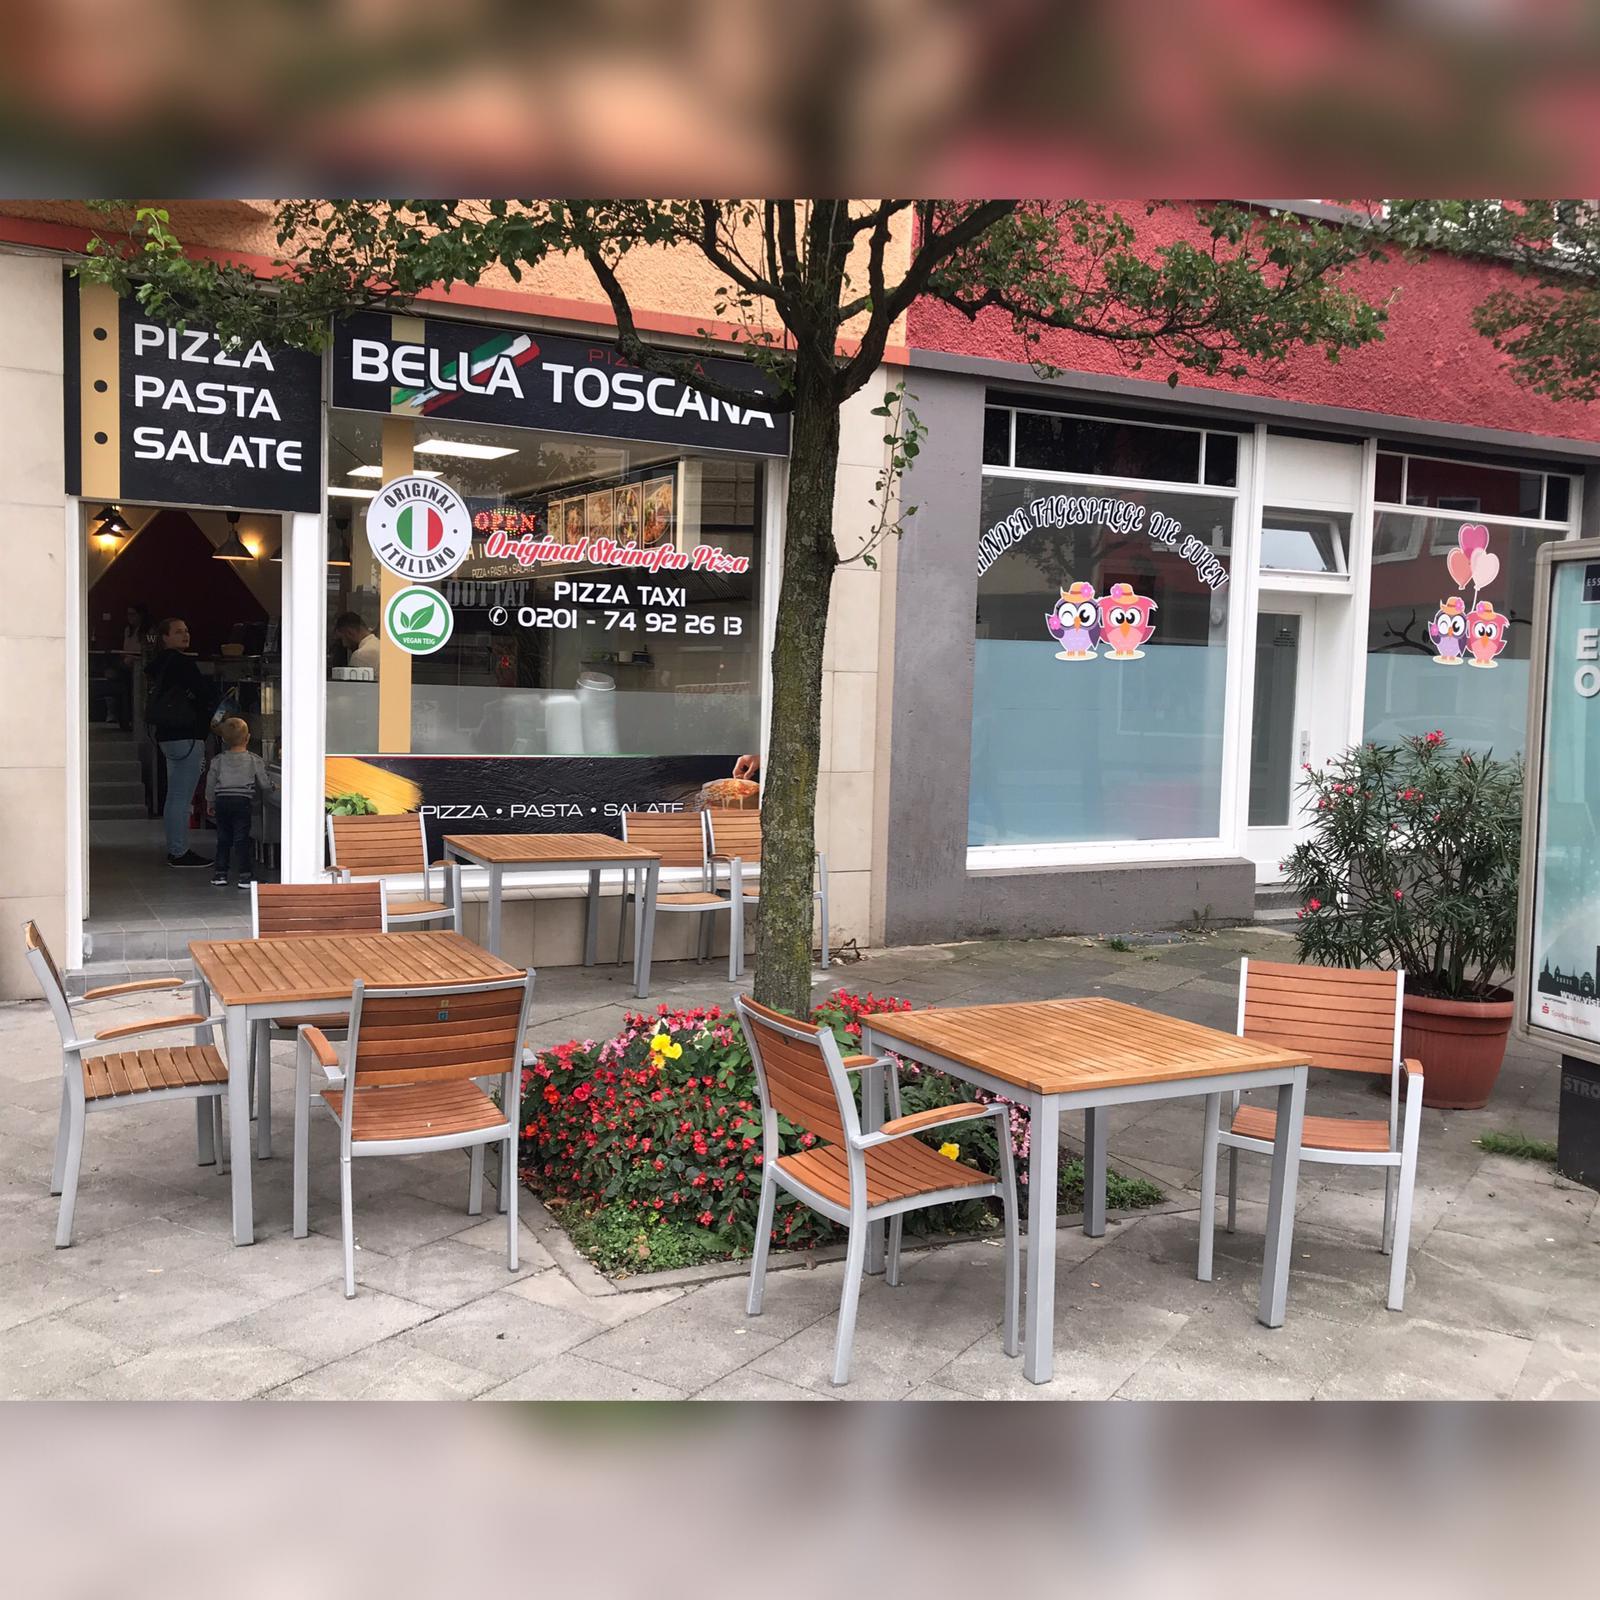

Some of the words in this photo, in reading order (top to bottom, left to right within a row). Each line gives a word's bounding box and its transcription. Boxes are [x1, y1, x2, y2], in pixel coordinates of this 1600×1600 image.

[134, 323, 275, 371] PIZZA
[134, 375, 281, 421] PASTA
[352, 338, 524, 399] BELLA
[542, 362, 775, 429] TOSCANA
[133, 426, 302, 472] SALATE
[384, 483, 456, 514] ORIGINAL
[474, 511, 536, 533] OPEN
[380, 543, 456, 573] ITALIANO
[485, 530, 590, 568] Original
[588, 537, 690, 574] Steinofen
[691, 544, 749, 574] Pizza
[1031, 495, 1145, 534] TAGESPFLEGE
[1148, 512, 1182, 546] DIE
[1179, 535, 1229, 590] EULEN
[554, 581, 630, 605] PIZZA
[637, 586, 686, 607] TAXI
[517, 607, 577, 629] 0201
[603, 610, 637, 631] 74
[645, 613, 677, 633] 92
[684, 614, 716, 635] 26
[723, 616, 743, 636] 13
[421, 805, 489, 820] PIZZA
[510, 803, 583, 818] PASTA
